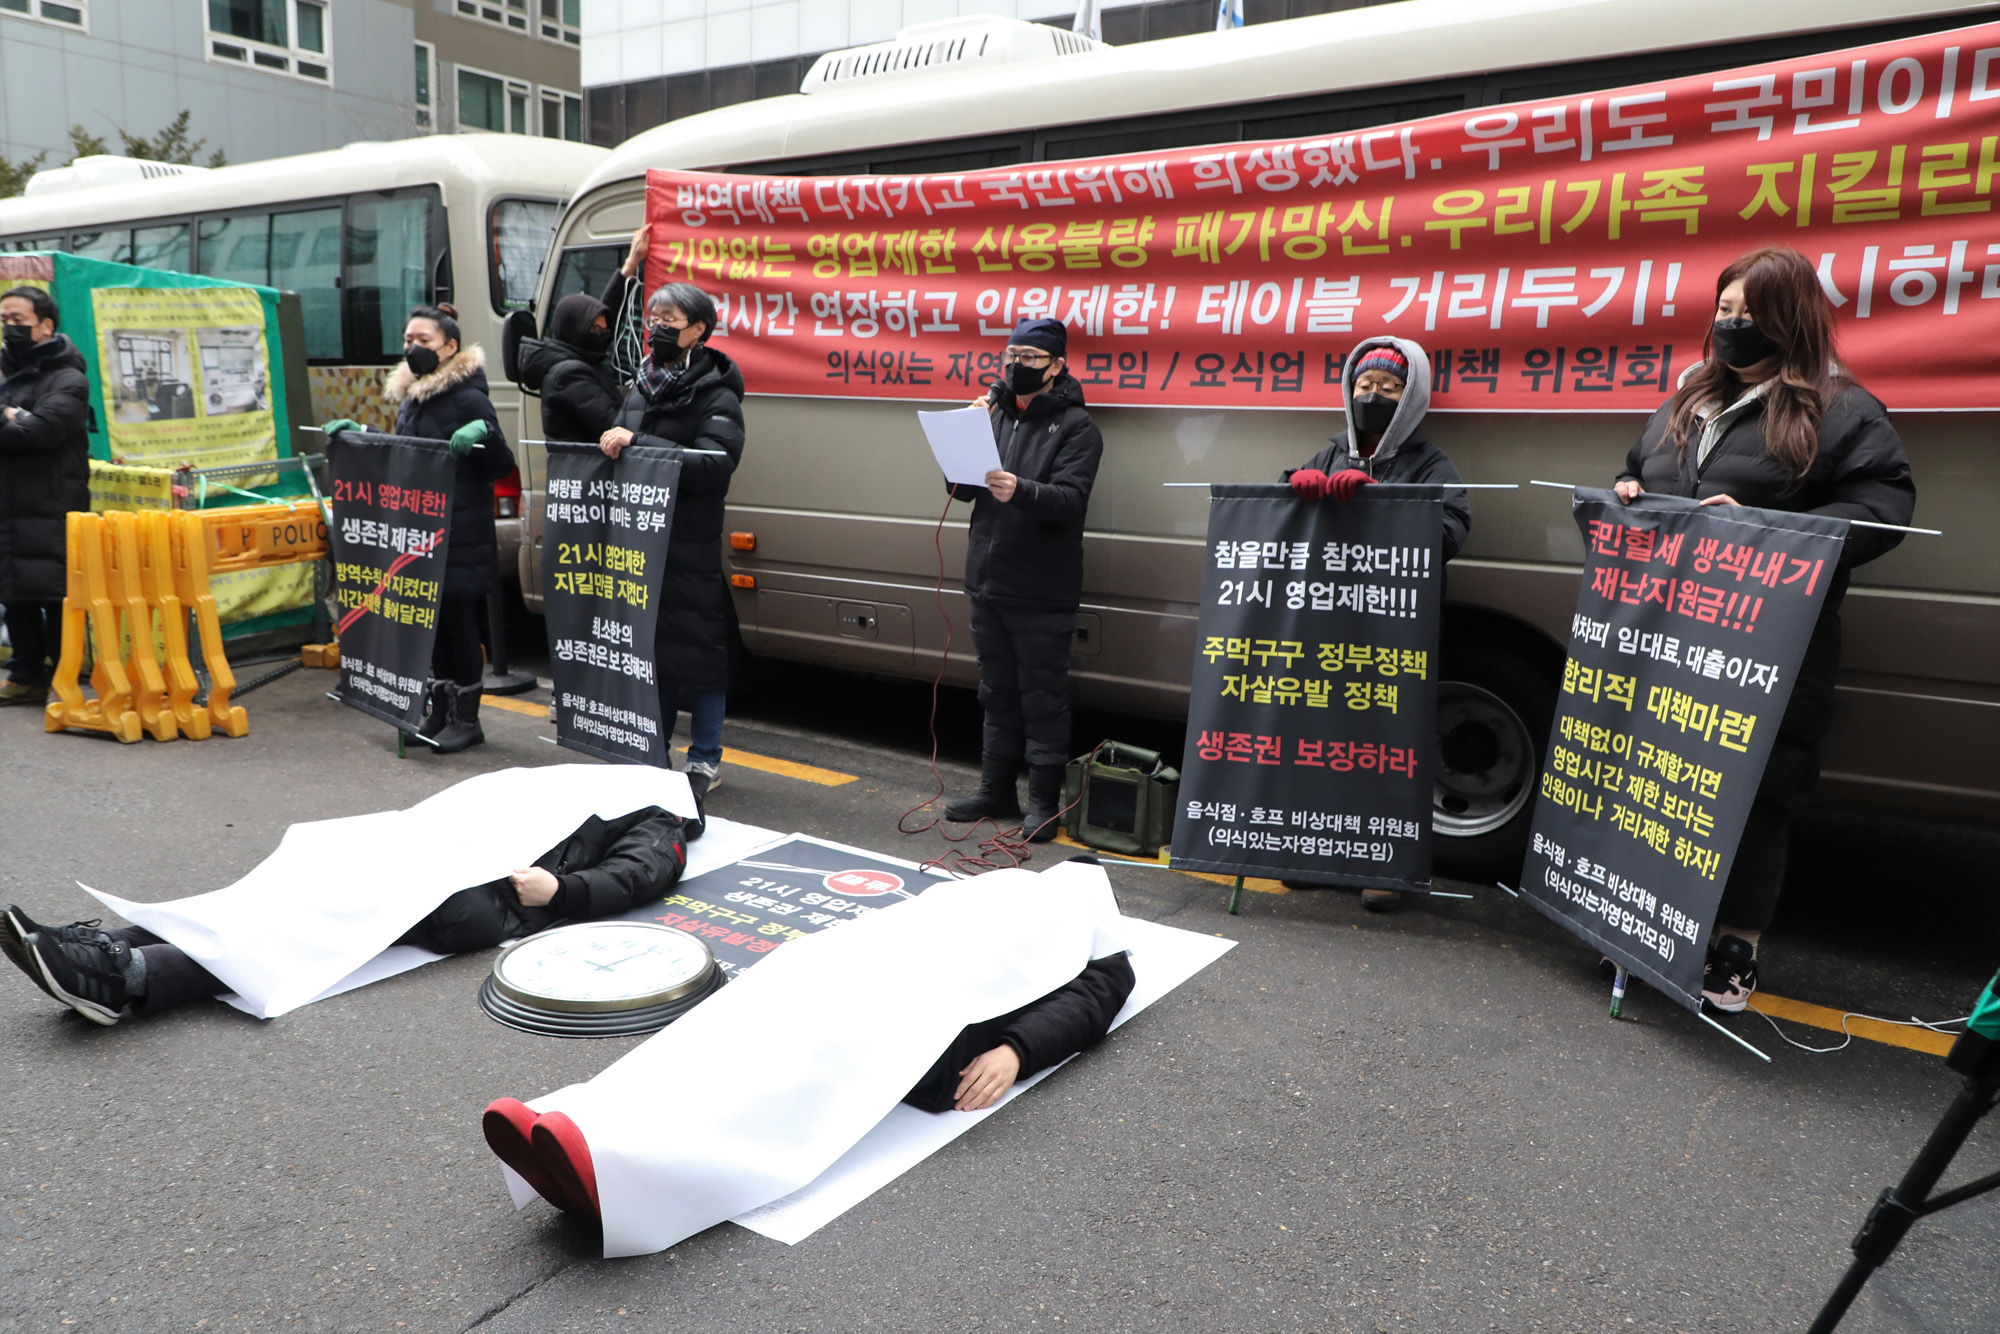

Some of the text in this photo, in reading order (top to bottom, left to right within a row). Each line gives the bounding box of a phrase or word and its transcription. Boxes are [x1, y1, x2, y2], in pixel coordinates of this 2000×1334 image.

[677, 179, 809, 227] 방역대책
[814, 175, 975, 220] 다지키고
[980, 160, 1174, 209] 국민위해
[667, 235, 796, 280] 기약없는
[807, 227, 957, 278] 영업제한
[971, 215, 1157, 272] 신용불량
[711, 240, 2000, 338] 업시간 연장하고 인원제한! 테이블 거리두기! 시하
[826, 350, 934, 385] 의식있는
[945, 351, 1005, 387] 자영
[1081, 350, 1148, 390] 모임
[1161, 351, 1180, 391] /
[1189, 350, 1304, 393] 요식업
[1520, 344, 1673, 394] 위원회
[334, 479, 446, 518] 21시 영업제한!
[548, 478, 583, 500] 벼랑끝
[621, 482, 670, 508] 자영업자
[273, 521, 328, 546] POLIC
[546, 503, 606, 524] 대책없이
[636, 510, 666, 533] 정부
[558, 543, 646, 576] 21시 영업제한
[1214, 540, 1430, 579] 참을만큼 참았다!!!
[1693, 536, 1824, 597] 생색내기
[554, 571, 648, 610] 지킬만큼 지켰다
[1217, 580, 1417, 619] 21시 영업제한!!!
[1590, 566, 1764, 634] 재난지원금!!!
[592, 616, 633, 648] 최소한의
[1571, 613, 1611, 649] 어차피
[1202, 636, 1428, 681] 주먹구구 정부정책
[1220, 674, 1398, 715] 자살유발 정책
[1562, 657, 1757, 753] 합리적 대책마련
[1196, 730, 1418, 779] 생존권 보장하라
[1560, 715, 1722, 800] 대책없이 규제할거면
[1553, 745, 1715, 837] 영업시간 제한 보다는
[1207, 825, 1394, 863] (의식있는자영업자모임)
[1291, 810, 1361, 834] 비상대책
[1367, 815, 1420, 841] 위원회
[1541, 772, 1721, 881] 인원이나 거리제한 하자!
[723, 891, 804, 916] 생존권
[739, 877, 802, 897] 21시
[663, 894, 760, 925] 주먹구구
[1544, 866, 1675, 963] (의식있는자영업자모임)
[1607, 872, 1657, 918] 비상대책
[1660, 903, 1700, 945] 위원회
